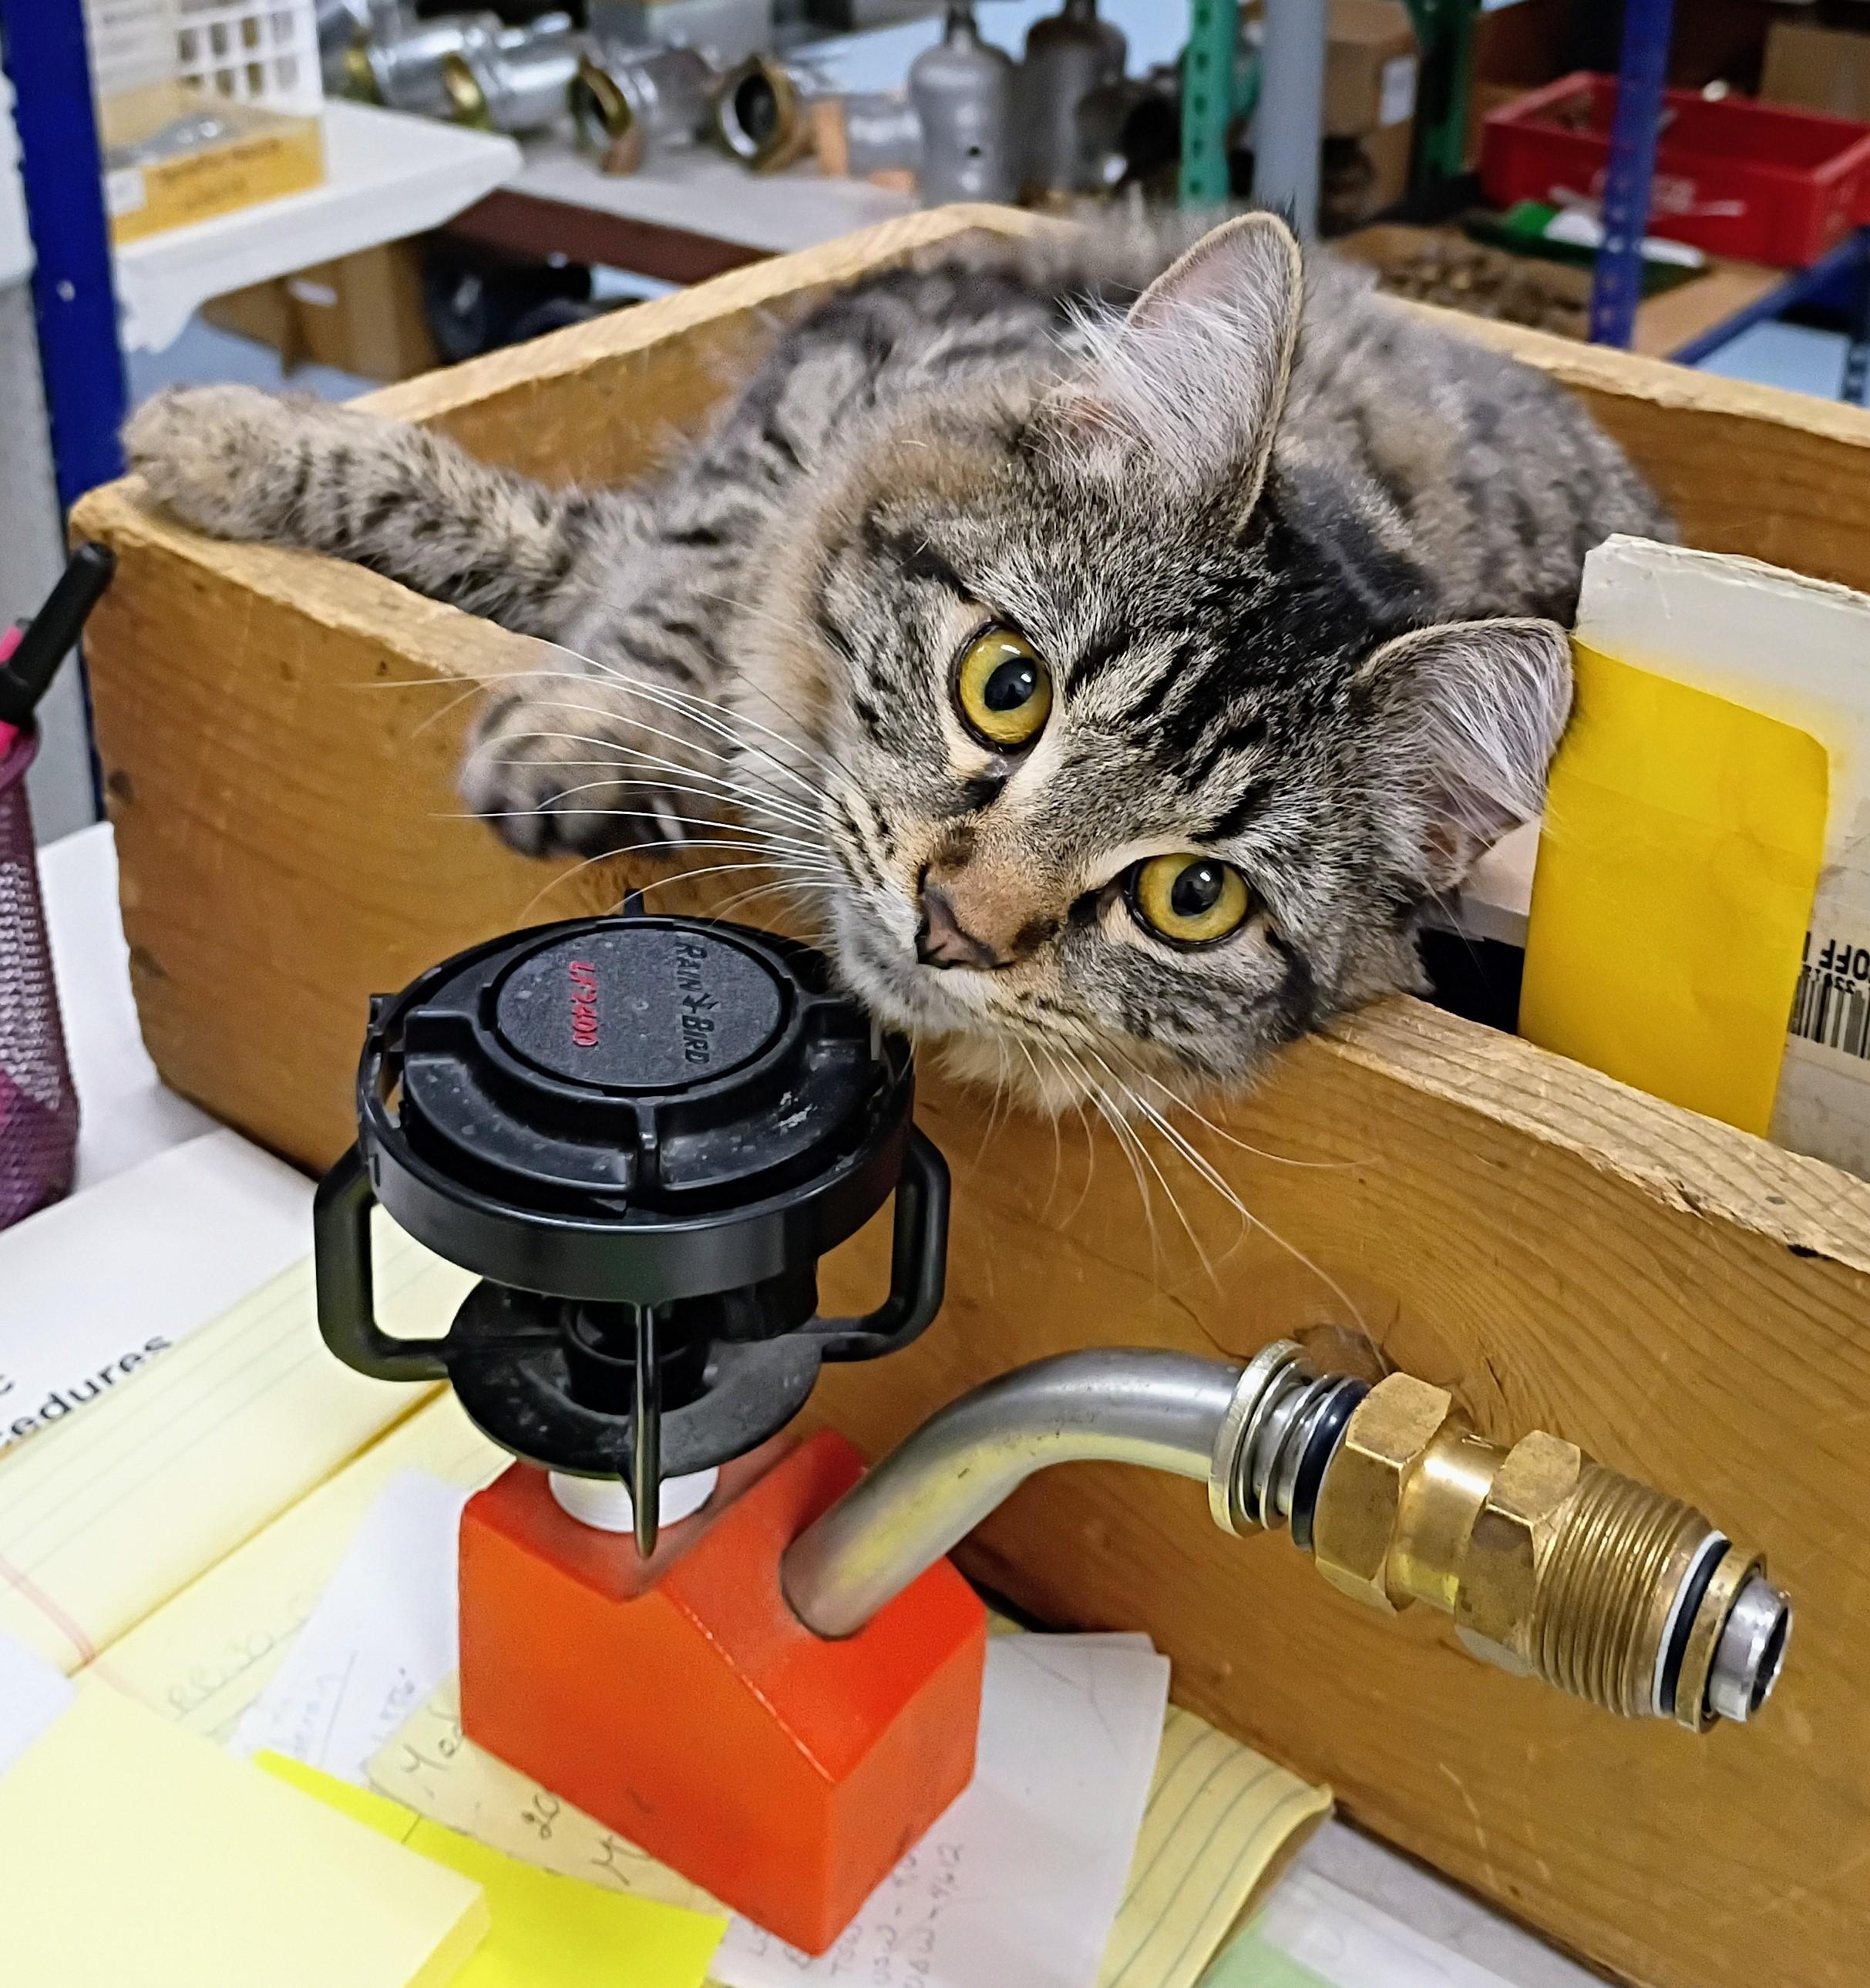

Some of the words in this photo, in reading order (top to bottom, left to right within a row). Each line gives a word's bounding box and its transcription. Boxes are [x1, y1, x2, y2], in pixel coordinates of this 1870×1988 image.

[675, 941, 708, 992] RAIN
[1819, 939, 1870, 981] OFF
[682, 1015, 715, 1065] BIRD
[0, 1336, 172, 1444] edures
